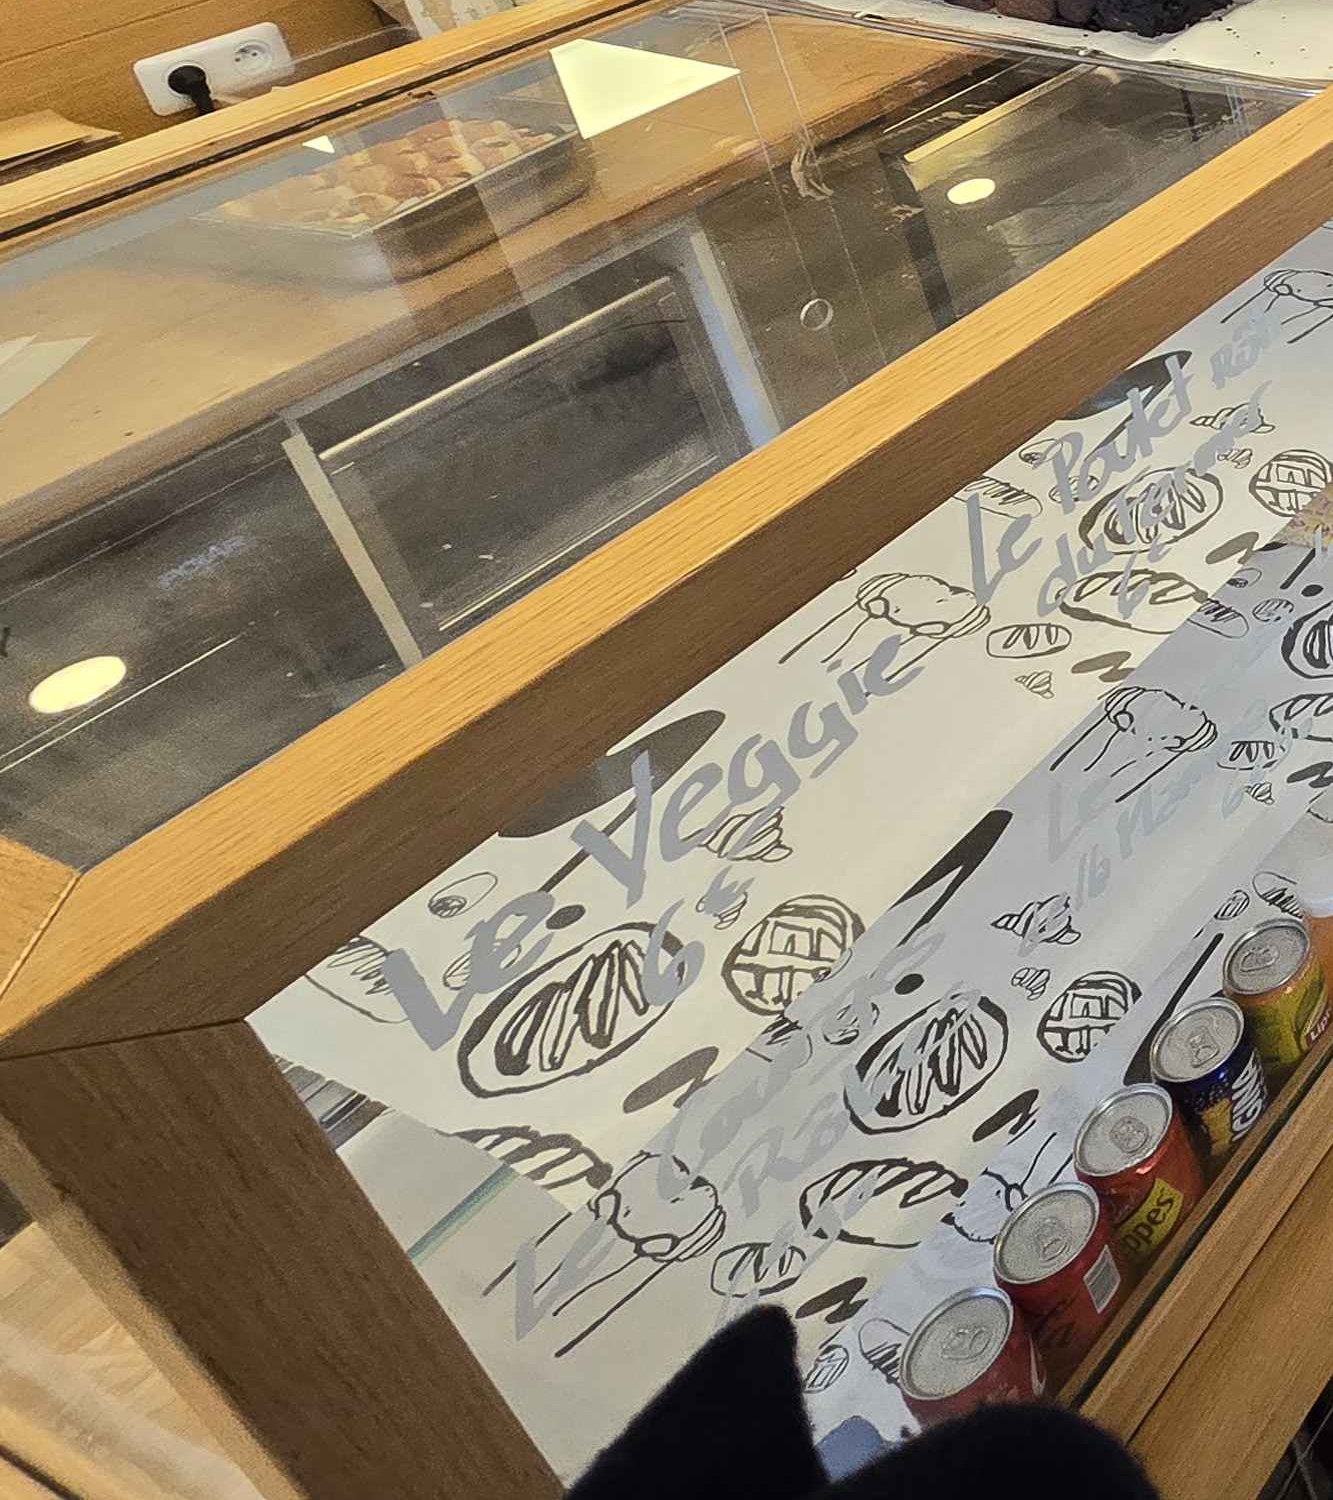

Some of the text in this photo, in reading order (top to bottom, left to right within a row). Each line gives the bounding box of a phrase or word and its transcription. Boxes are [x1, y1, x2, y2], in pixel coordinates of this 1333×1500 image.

[966, 492, 1043, 608] Le
[382, 890, 557, 1053] Le
[570, 633, 925, 910] Veggie
